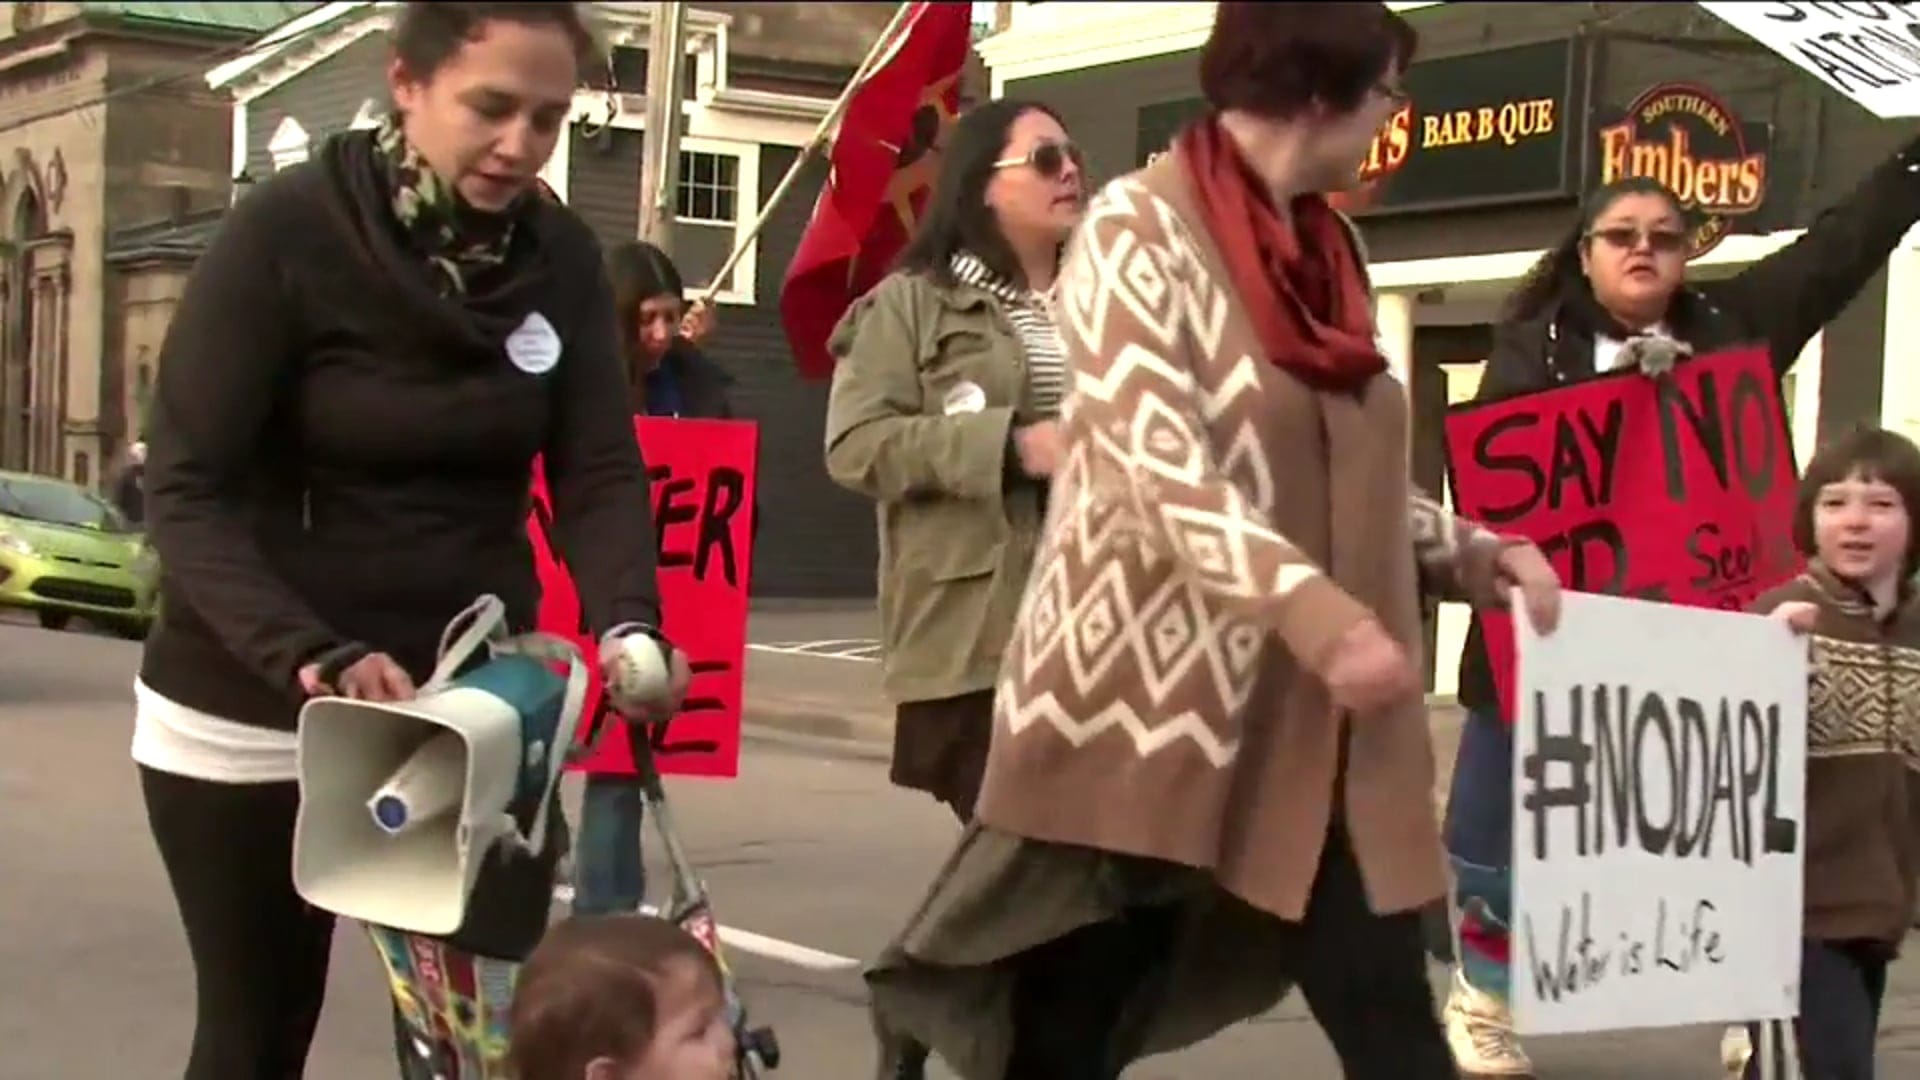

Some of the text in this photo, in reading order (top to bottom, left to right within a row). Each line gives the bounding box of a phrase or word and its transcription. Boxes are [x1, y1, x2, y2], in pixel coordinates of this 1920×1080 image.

[1422, 111, 1473, 149] BAR
[1498, 99, 1555, 145] QUE
[1600, 122, 1762, 205] Embers
[1642, 95, 1730, 137] SOUTHERN
[1473, 369, 1776, 523] SAY NO
[1524, 682, 1797, 868] #NODAPL
[1524, 890, 1725, 1002] Water is Life
